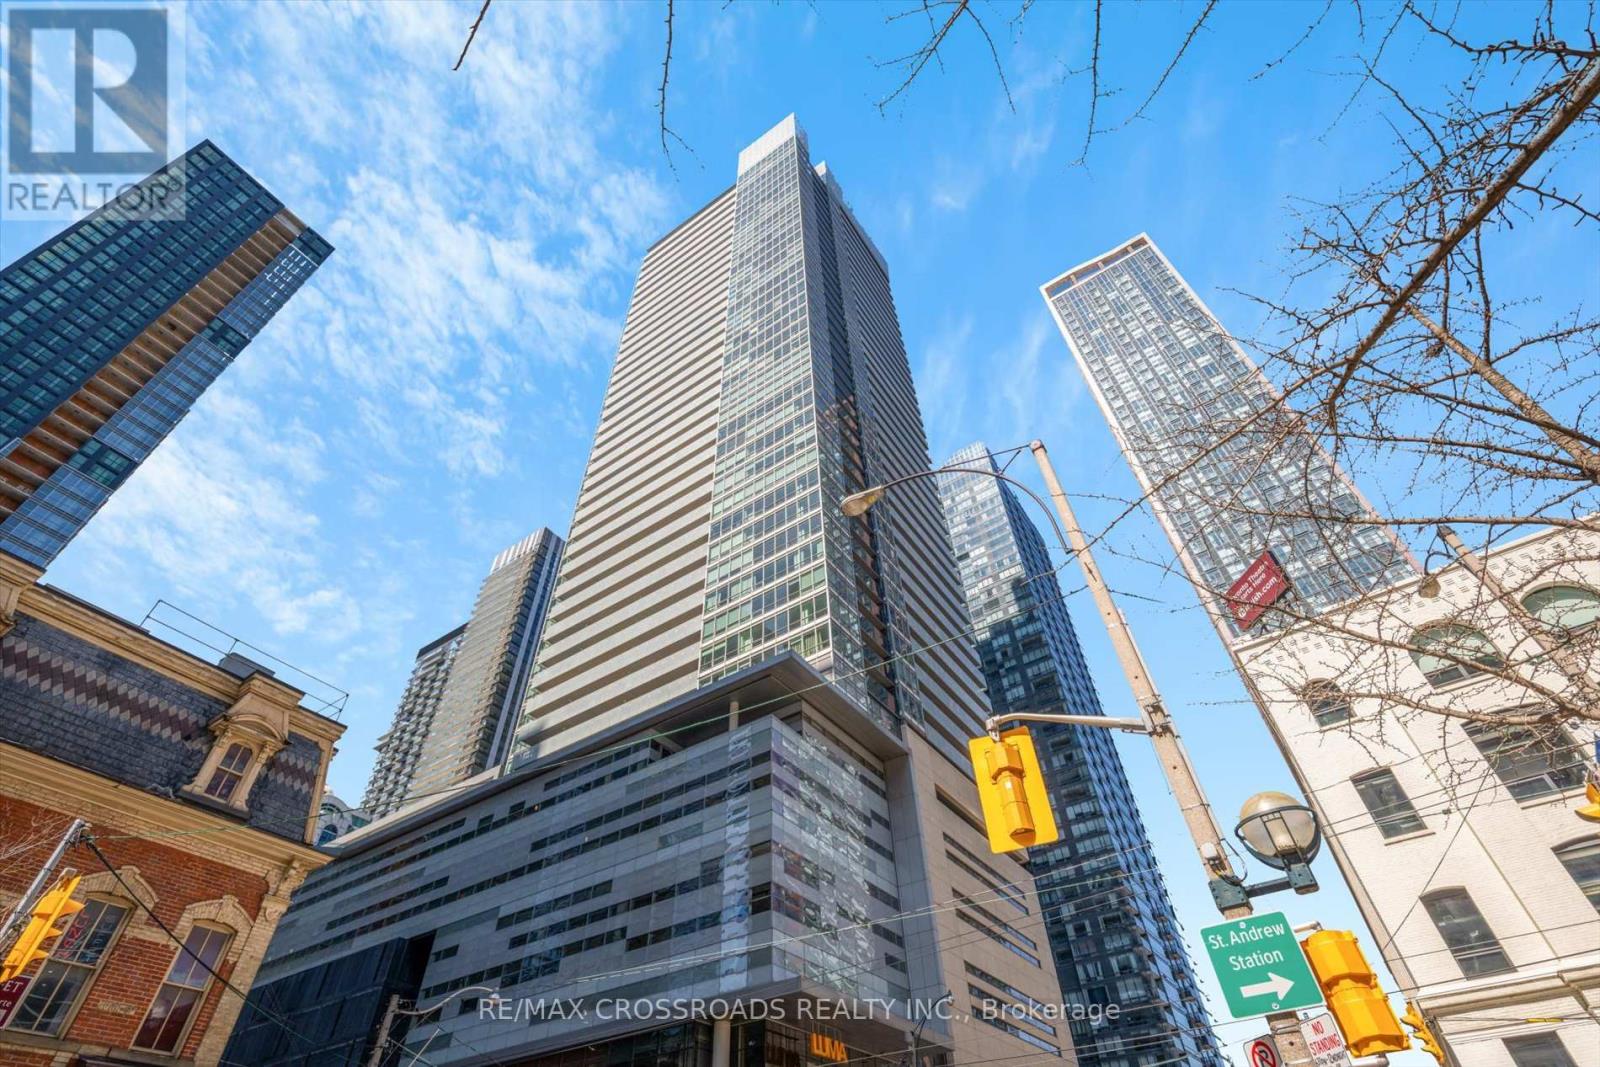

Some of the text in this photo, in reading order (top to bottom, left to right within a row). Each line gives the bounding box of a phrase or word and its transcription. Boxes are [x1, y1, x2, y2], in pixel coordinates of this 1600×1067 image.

[1208, 923, 1285, 950] St. Andrew
[1229, 950, 1284, 971] Station
[1311, 1020, 1324, 1036] NO
[810, 1032, 849, 1064] LUMA
[1309, 1033, 1341, 1056] STANDING
